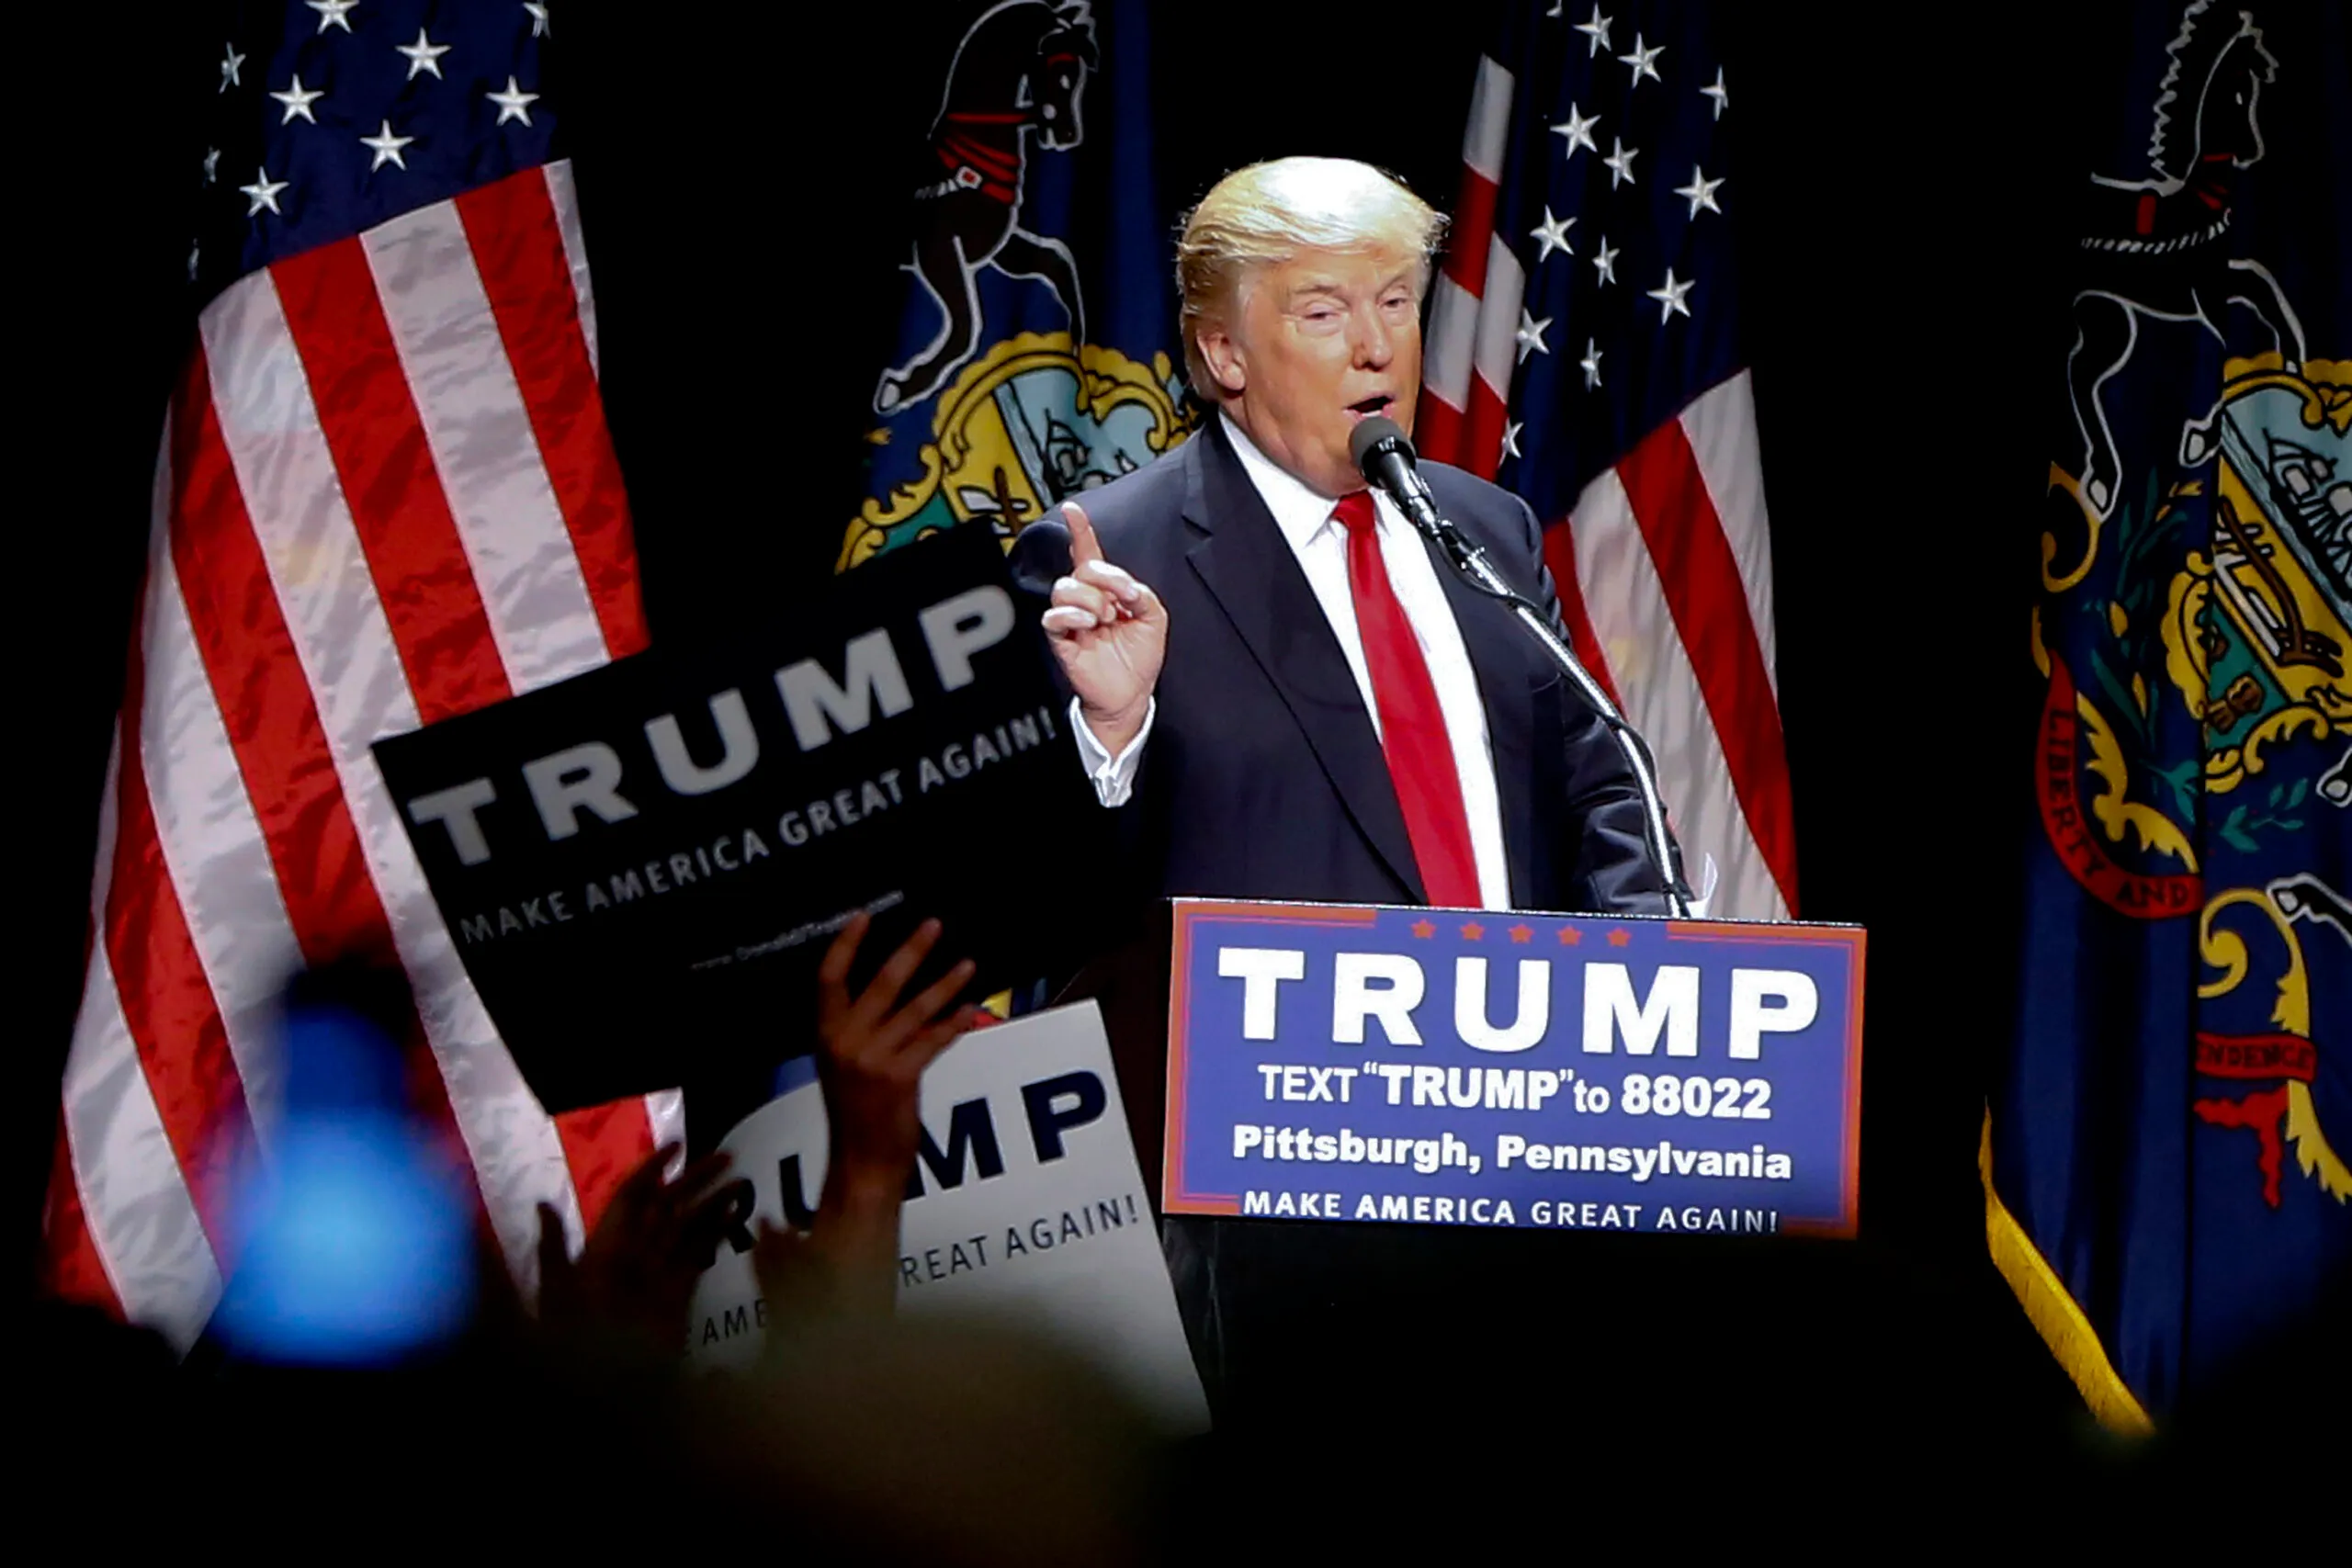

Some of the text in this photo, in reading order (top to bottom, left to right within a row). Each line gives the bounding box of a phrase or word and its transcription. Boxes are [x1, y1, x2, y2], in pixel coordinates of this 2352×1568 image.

[408, 585, 1015, 864] TRUMP
[461, 705, 1057, 944] MAKE AMERICA GREAT AGAIN!
[2047, 706, 2189, 908] LIBERTY AND
[1217, 947, 1819, 1060] TRUMP
[1258, 1064, 1359, 1103] TEXT
[1574, 1079, 1611, 1113] to
[1622, 1074, 1771, 1120] 88022
[712, 1070, 1106, 1253] RUMP
[1233, 1124, 1792, 1181] Pittsburgh, Pennsylvania
[899, 1193, 1138, 1288] REAT AGAIN!
[1243, 1190, 1778, 1233] MAKE AMERICA GREAT AGAIN!
